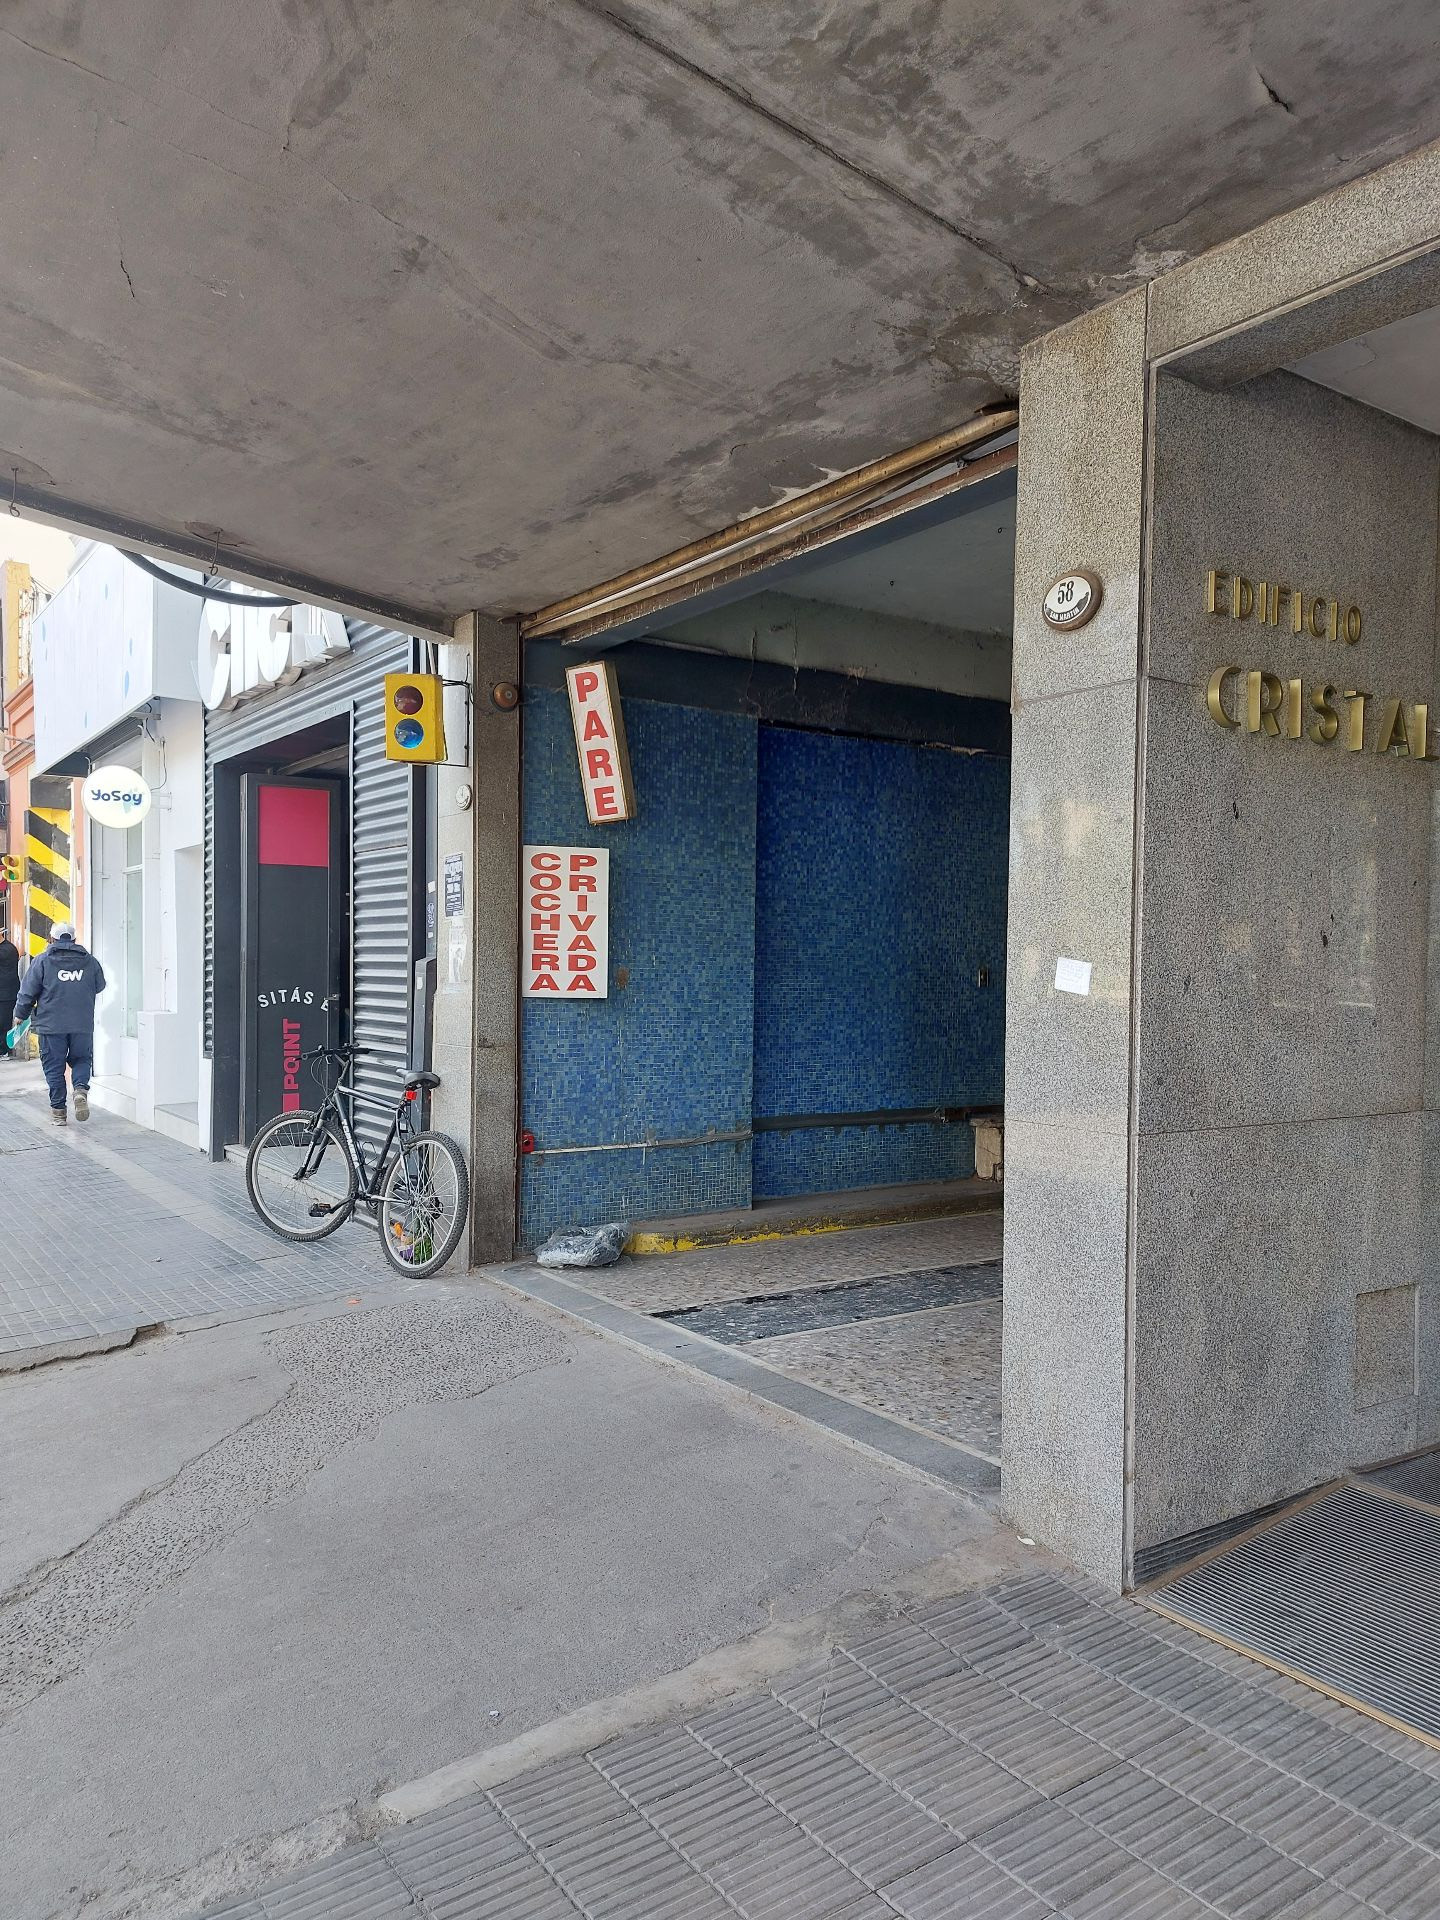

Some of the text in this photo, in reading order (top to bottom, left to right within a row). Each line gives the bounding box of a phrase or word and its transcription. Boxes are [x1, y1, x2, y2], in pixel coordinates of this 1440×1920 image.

[1057, 580, 1075, 605] 58
[1207, 570, 1362, 645] EDIFICIO
[574, 671, 619, 818] PARE
[1207, 666, 1439, 762] CRISTAL
[530, 852, 561, 992] COCHERA
[566, 854, 599, 992] PRIVADA
[57, 969, 84, 982] GW
[282, 1018, 301, 1090] POINT
